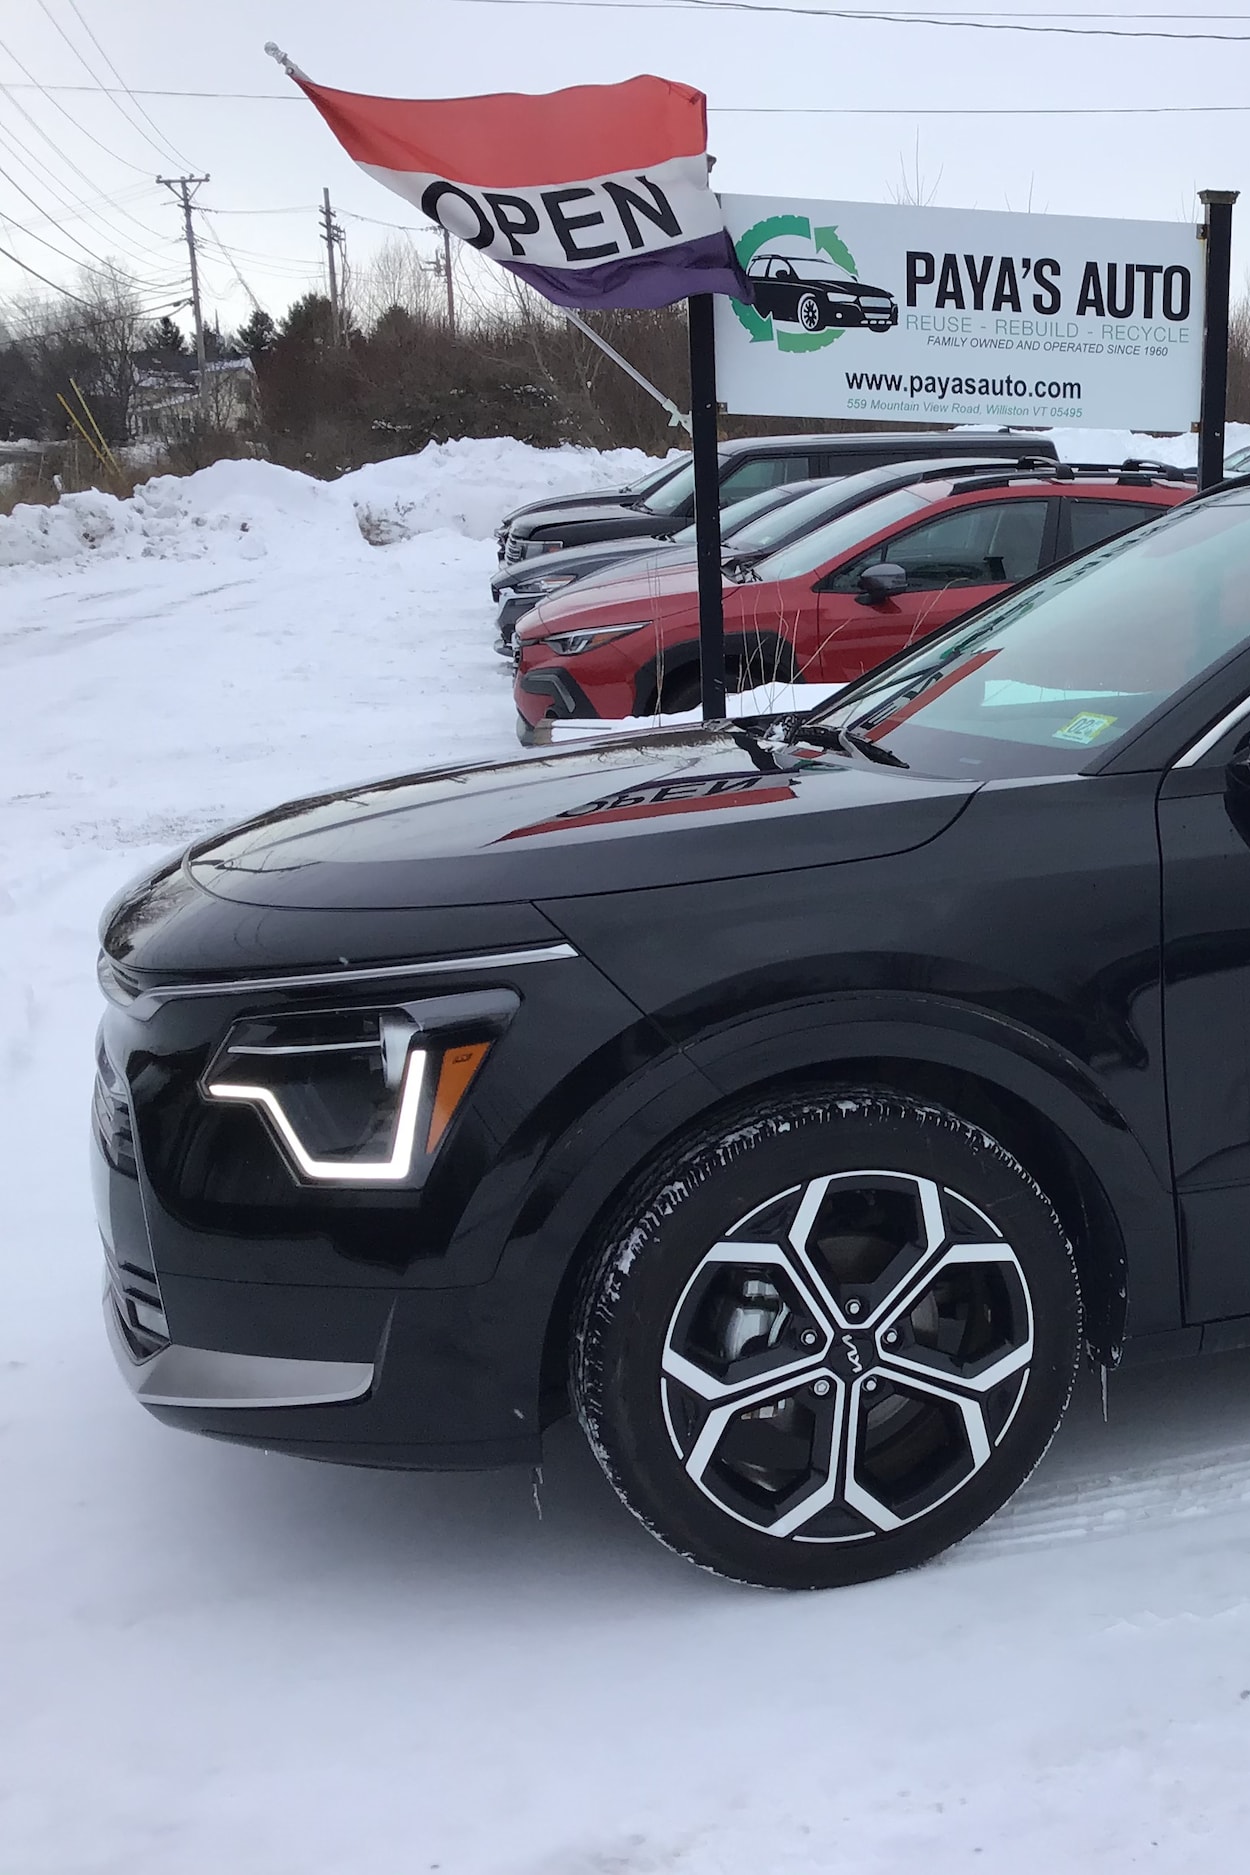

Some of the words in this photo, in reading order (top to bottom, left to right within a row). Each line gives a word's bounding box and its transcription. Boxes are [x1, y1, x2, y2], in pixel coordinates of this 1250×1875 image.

[421, 175, 683, 262] OPEN
[906, 250, 1061, 315] PAYA'S
[1076, 261, 1191, 321] AUTO
[906, 314, 972, 333] REUSE
[995, 319, 1079, 338] REBUILD
[1102, 324, 1190, 343] RECYCLE
[927, 335, 968, 348] FAMILY
[970, 338, 1015, 351] OWNED
[1016, 340, 1042, 351] AND
[1043, 341, 1104, 354] OPERATED
[1106, 344, 1141, 355] SINCE
[1144, 346, 1168, 357] 1960
[845, 372, 1082, 399] www.payasauto.com
[847, 398, 867, 409] 559
[870, 399, 920, 412] Mountain
[923, 402, 949, 413] View
[951, 403, 982, 415] Road,
[986, 404, 1029, 416] Williston
[1033, 407, 1048, 417] VT
[1050, 407, 1083, 418] 05495
